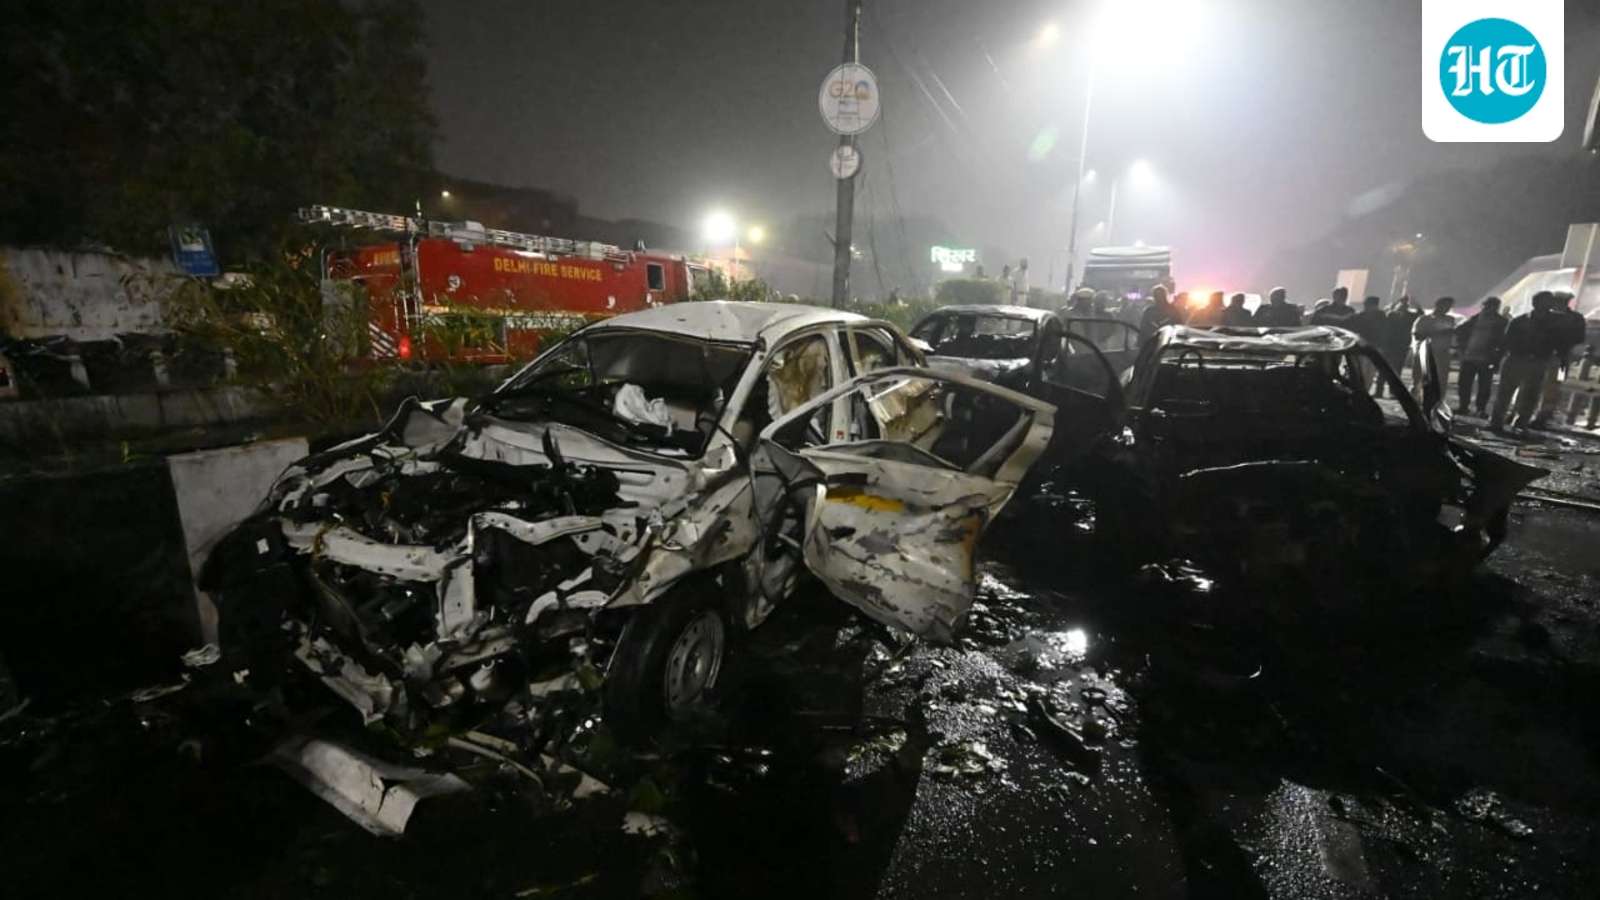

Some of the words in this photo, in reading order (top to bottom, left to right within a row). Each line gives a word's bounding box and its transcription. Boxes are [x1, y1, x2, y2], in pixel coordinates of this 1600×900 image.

[494, 257, 530, 273] DELHI
[533, 262, 559, 277] FIRE
[561, 265, 603, 282] SERVICE
